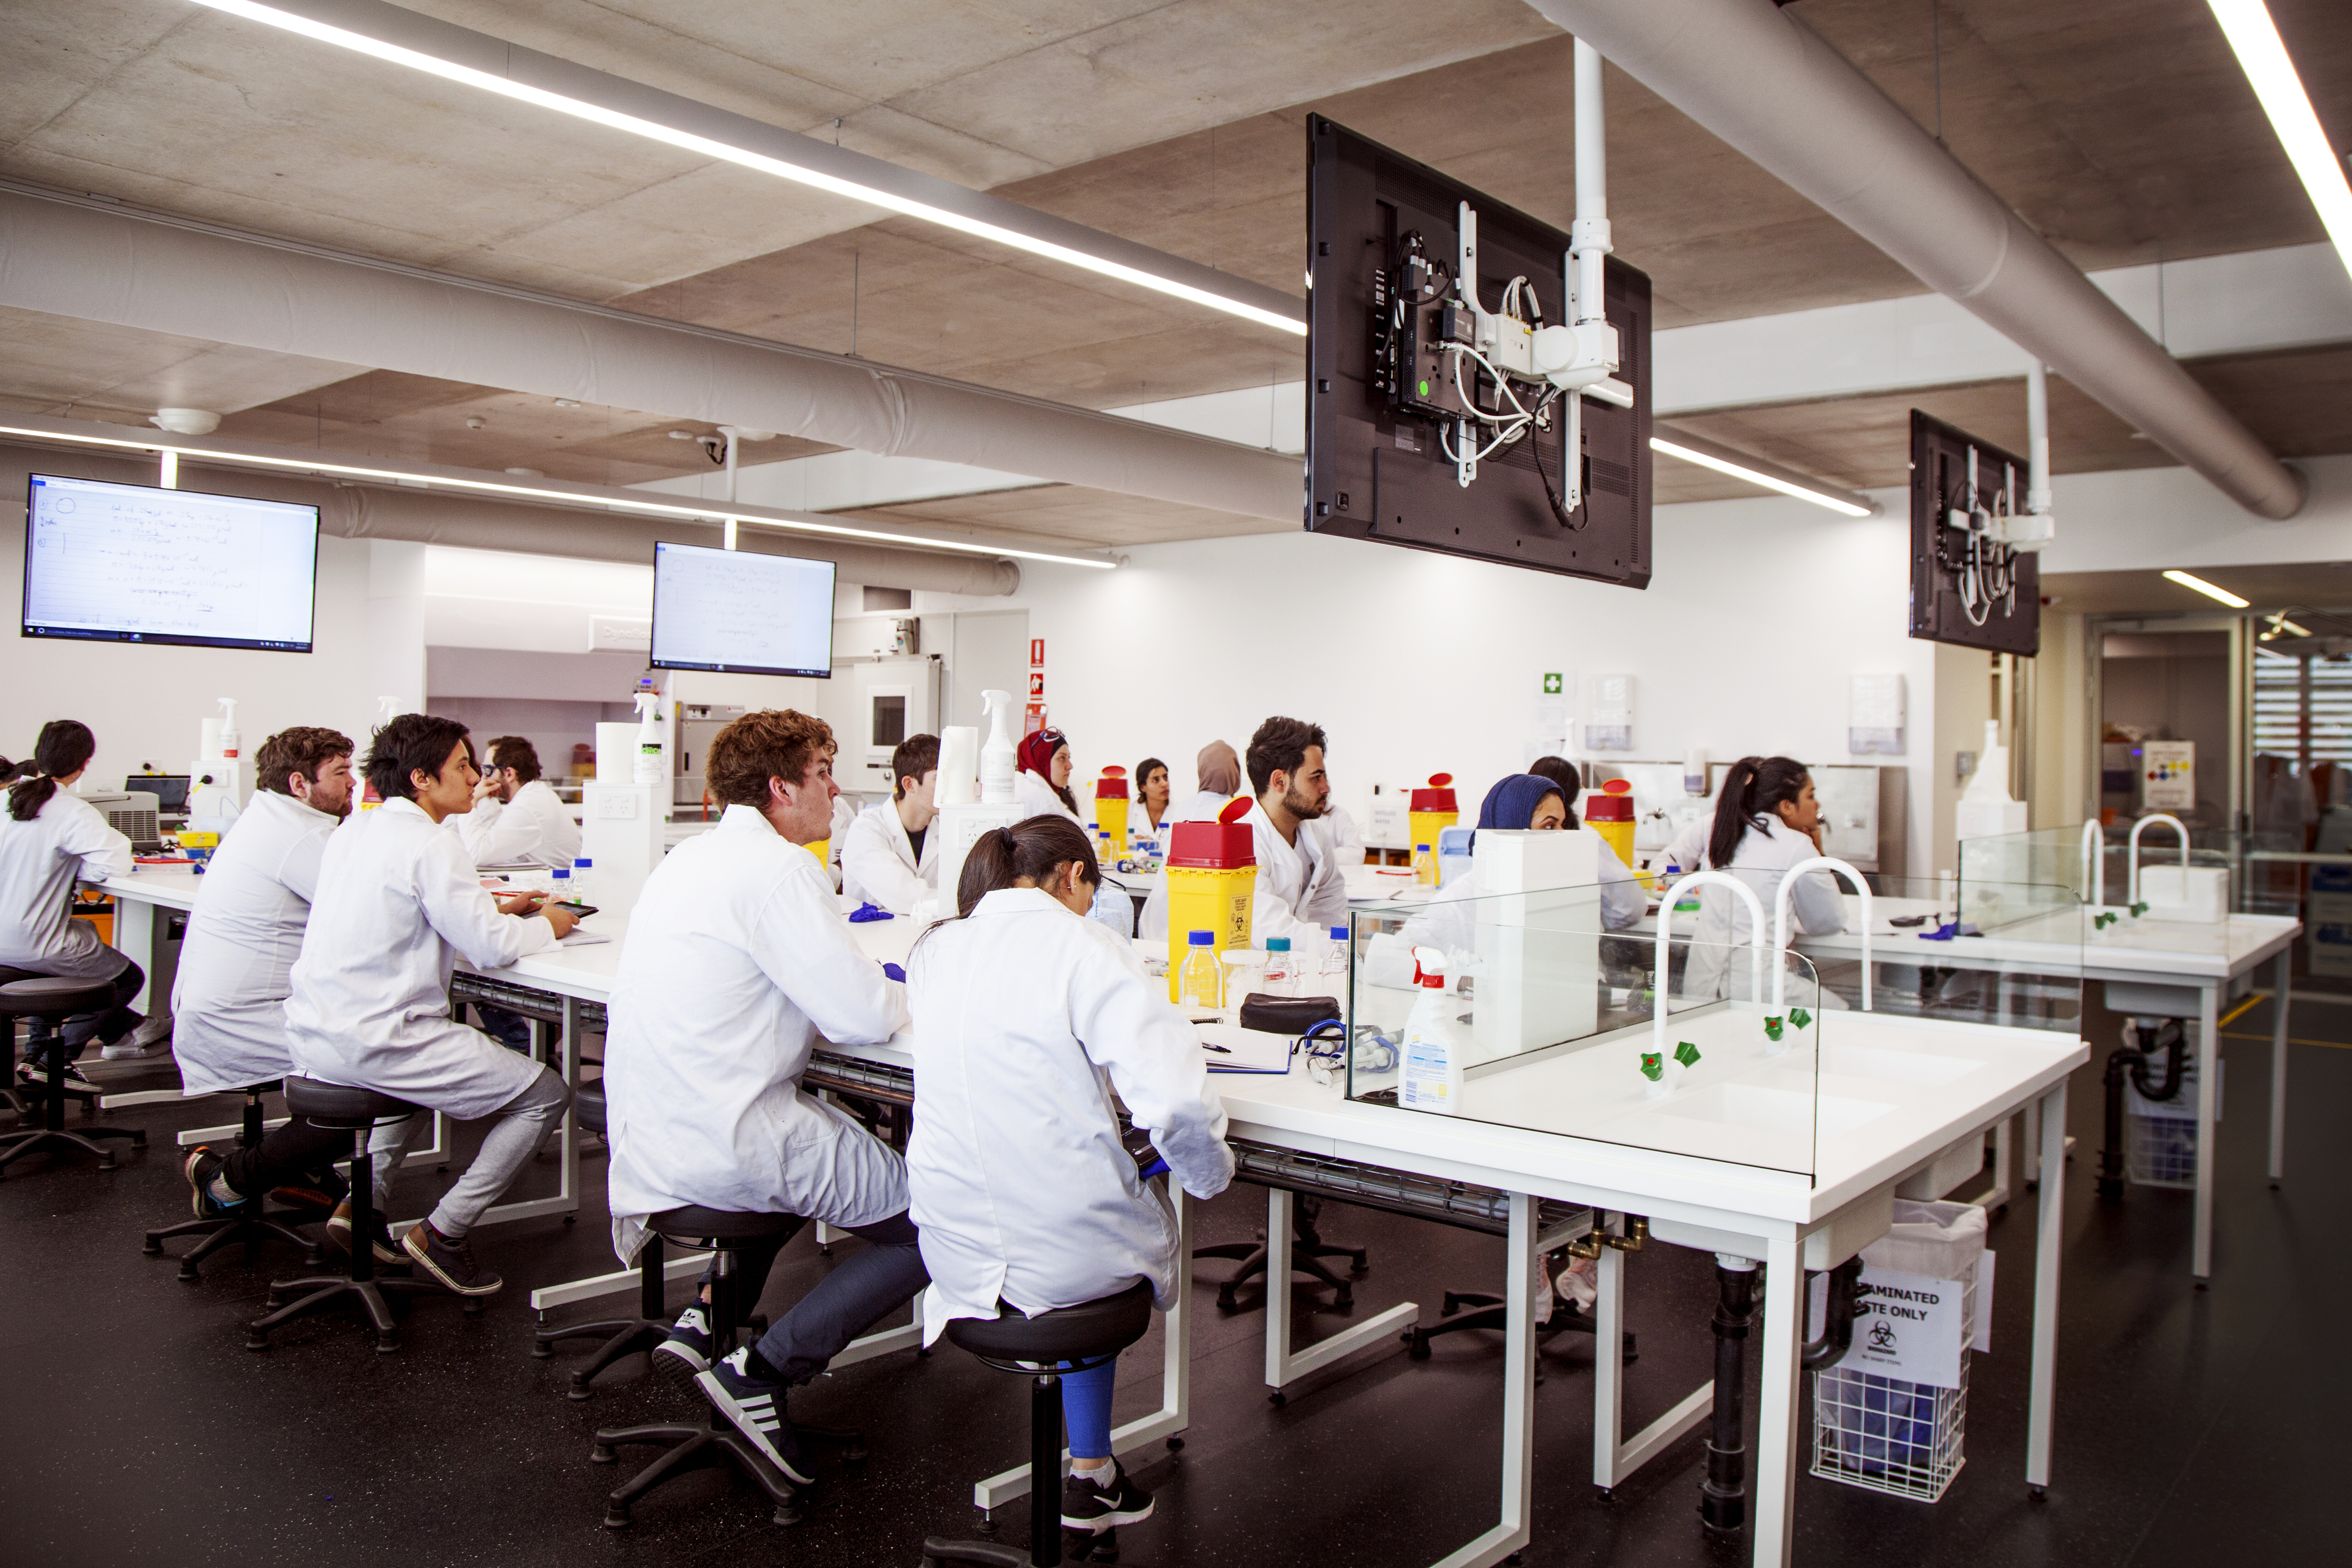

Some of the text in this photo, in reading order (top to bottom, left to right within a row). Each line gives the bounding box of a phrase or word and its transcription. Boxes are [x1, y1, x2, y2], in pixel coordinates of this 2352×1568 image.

[1863, 1283, 1940, 1305] AMINATED
[1891, 1306, 1928, 1321] ONLY
[1867, 1345, 1896, 1356] BIOHAZARD
